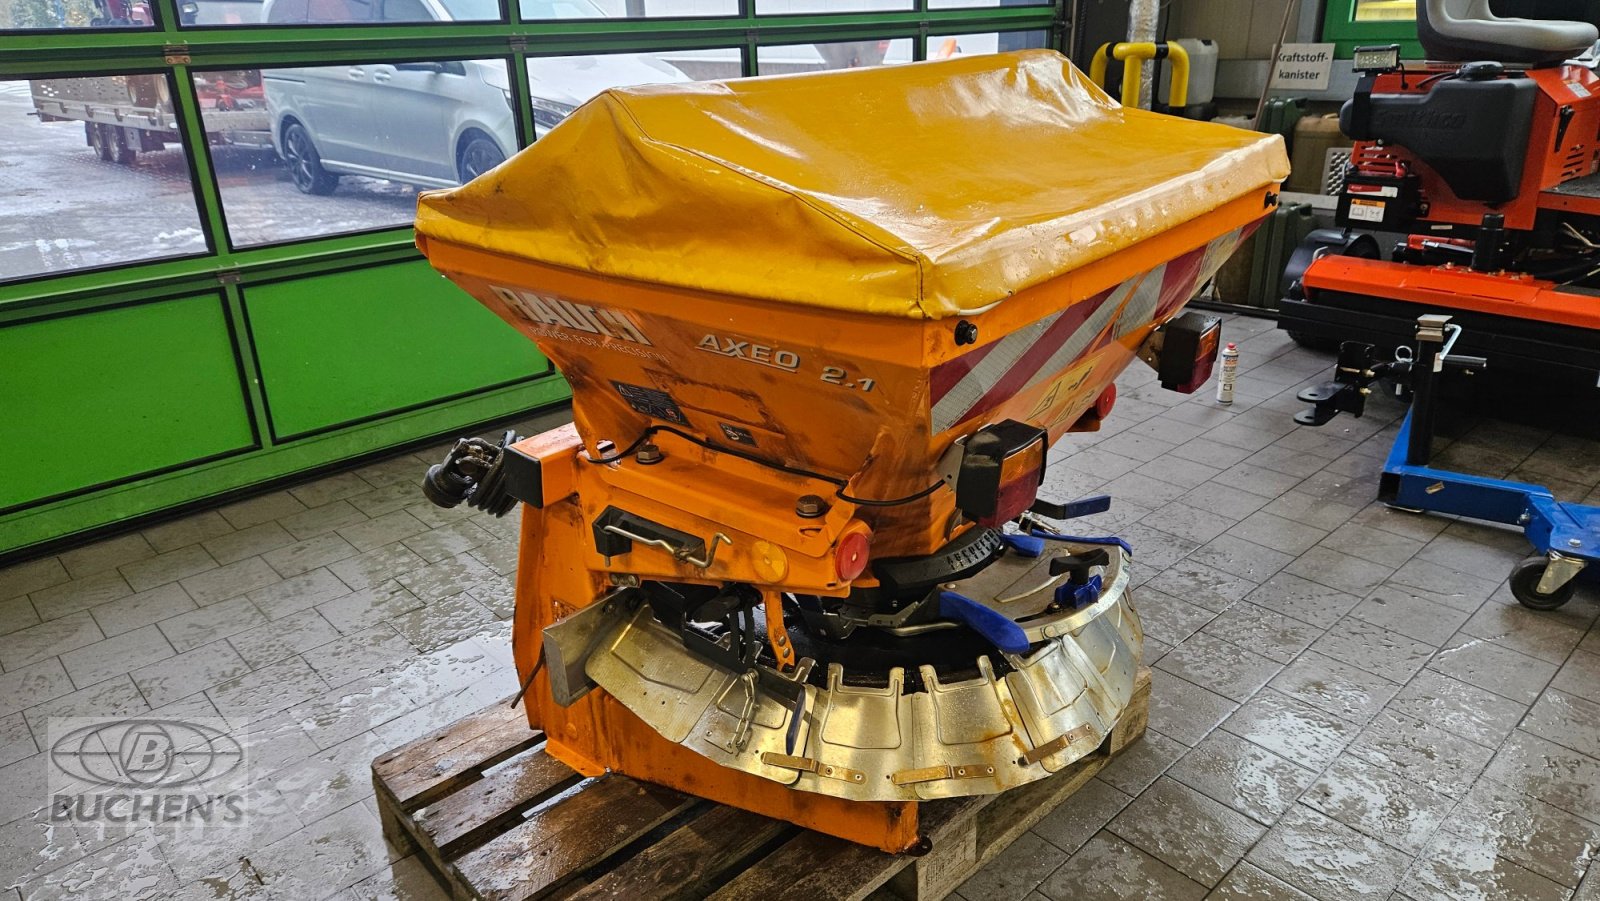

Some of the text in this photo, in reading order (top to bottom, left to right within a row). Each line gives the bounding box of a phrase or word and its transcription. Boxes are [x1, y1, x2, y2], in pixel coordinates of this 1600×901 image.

[1279, 69, 1320, 79] kanister
[489, 284, 654, 346] RAUCH
[698, 334, 876, 392] AXEO 2.1
